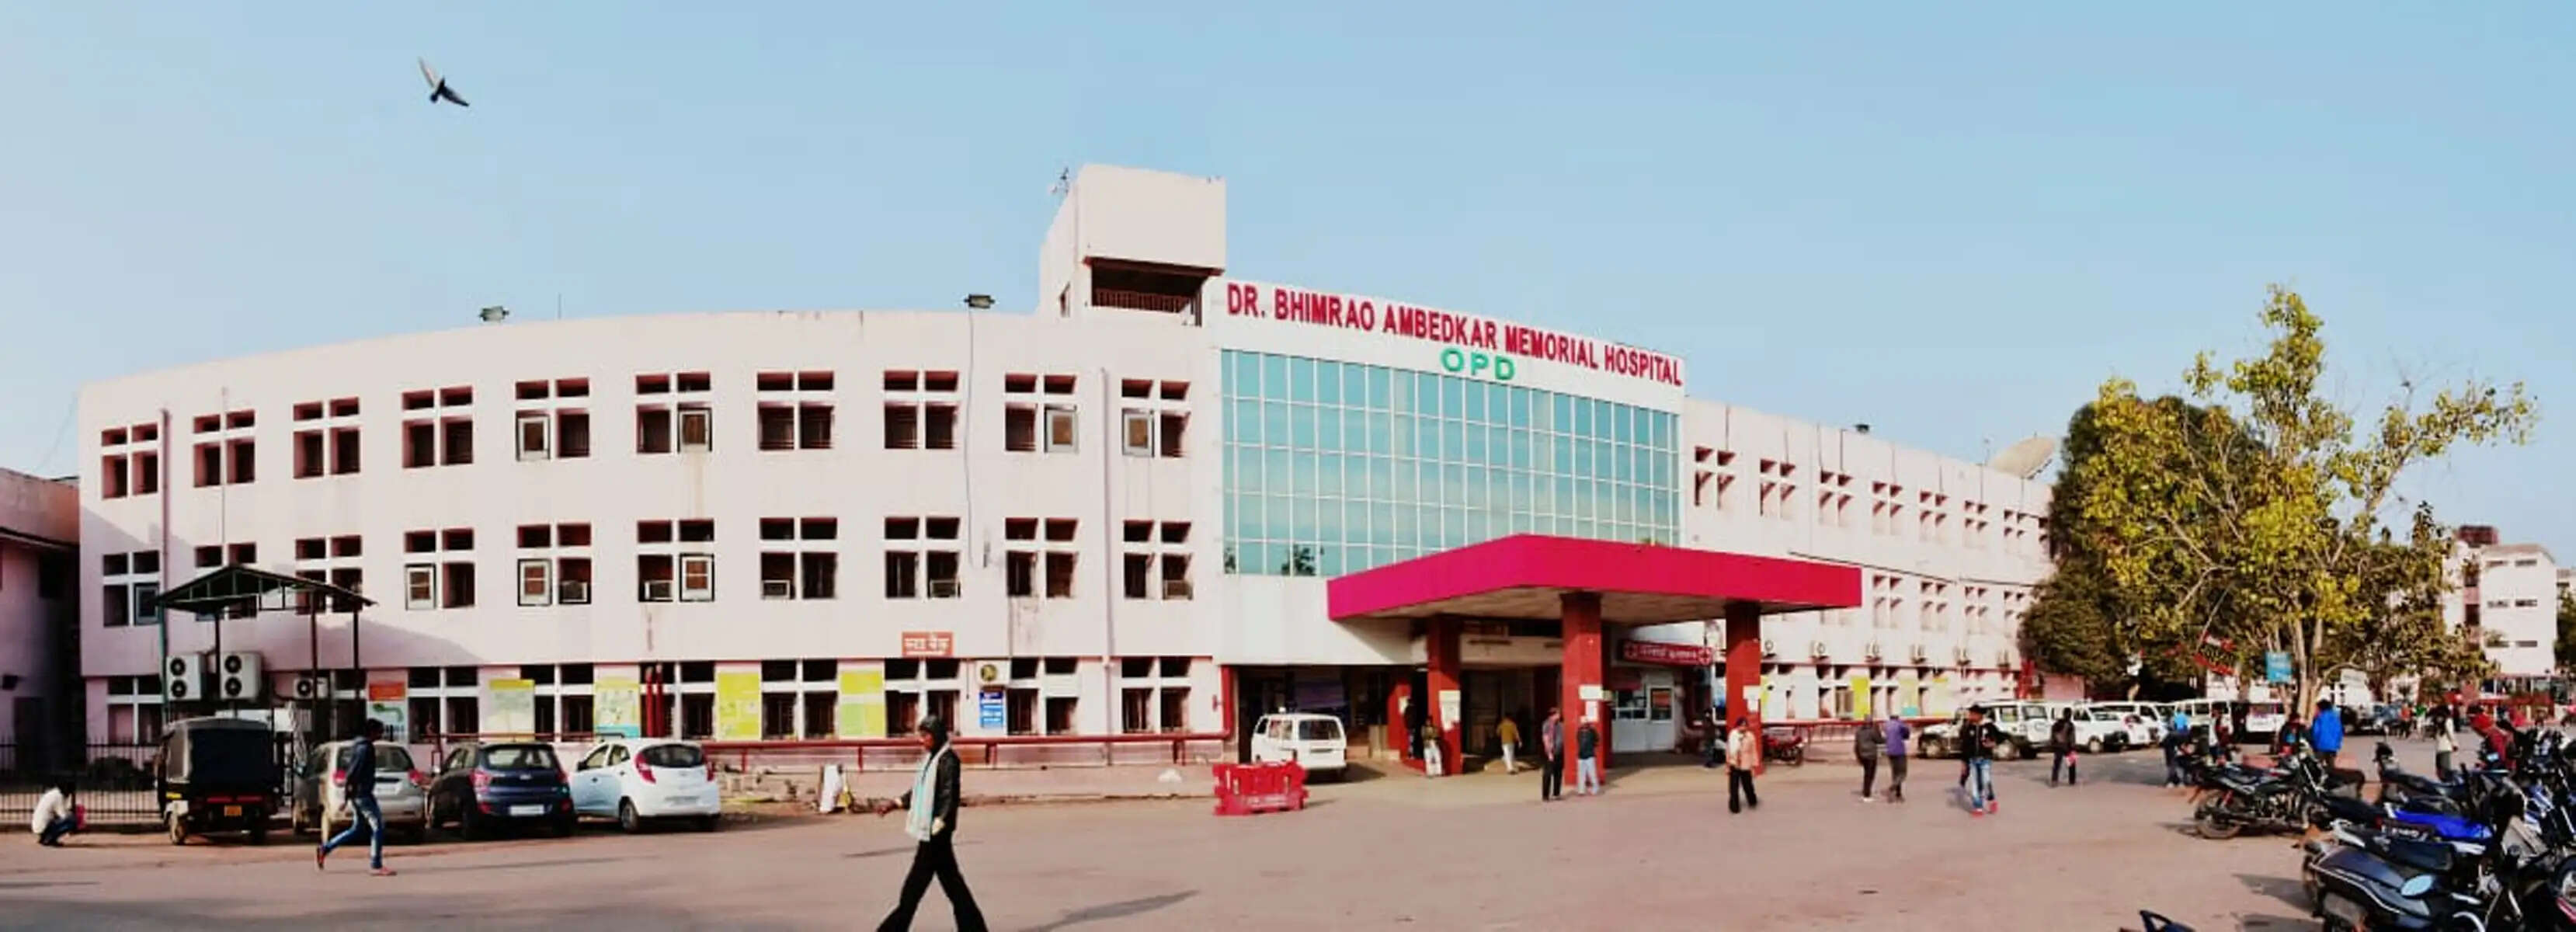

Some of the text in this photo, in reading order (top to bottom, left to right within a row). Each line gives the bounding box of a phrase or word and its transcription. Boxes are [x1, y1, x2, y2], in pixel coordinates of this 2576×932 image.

[1227, 283, 1683, 387] DR. BHIMRAO AMBEDKAR MEMORIAL HOSPITAL
[1441, 347, 1515, 381] OPD
